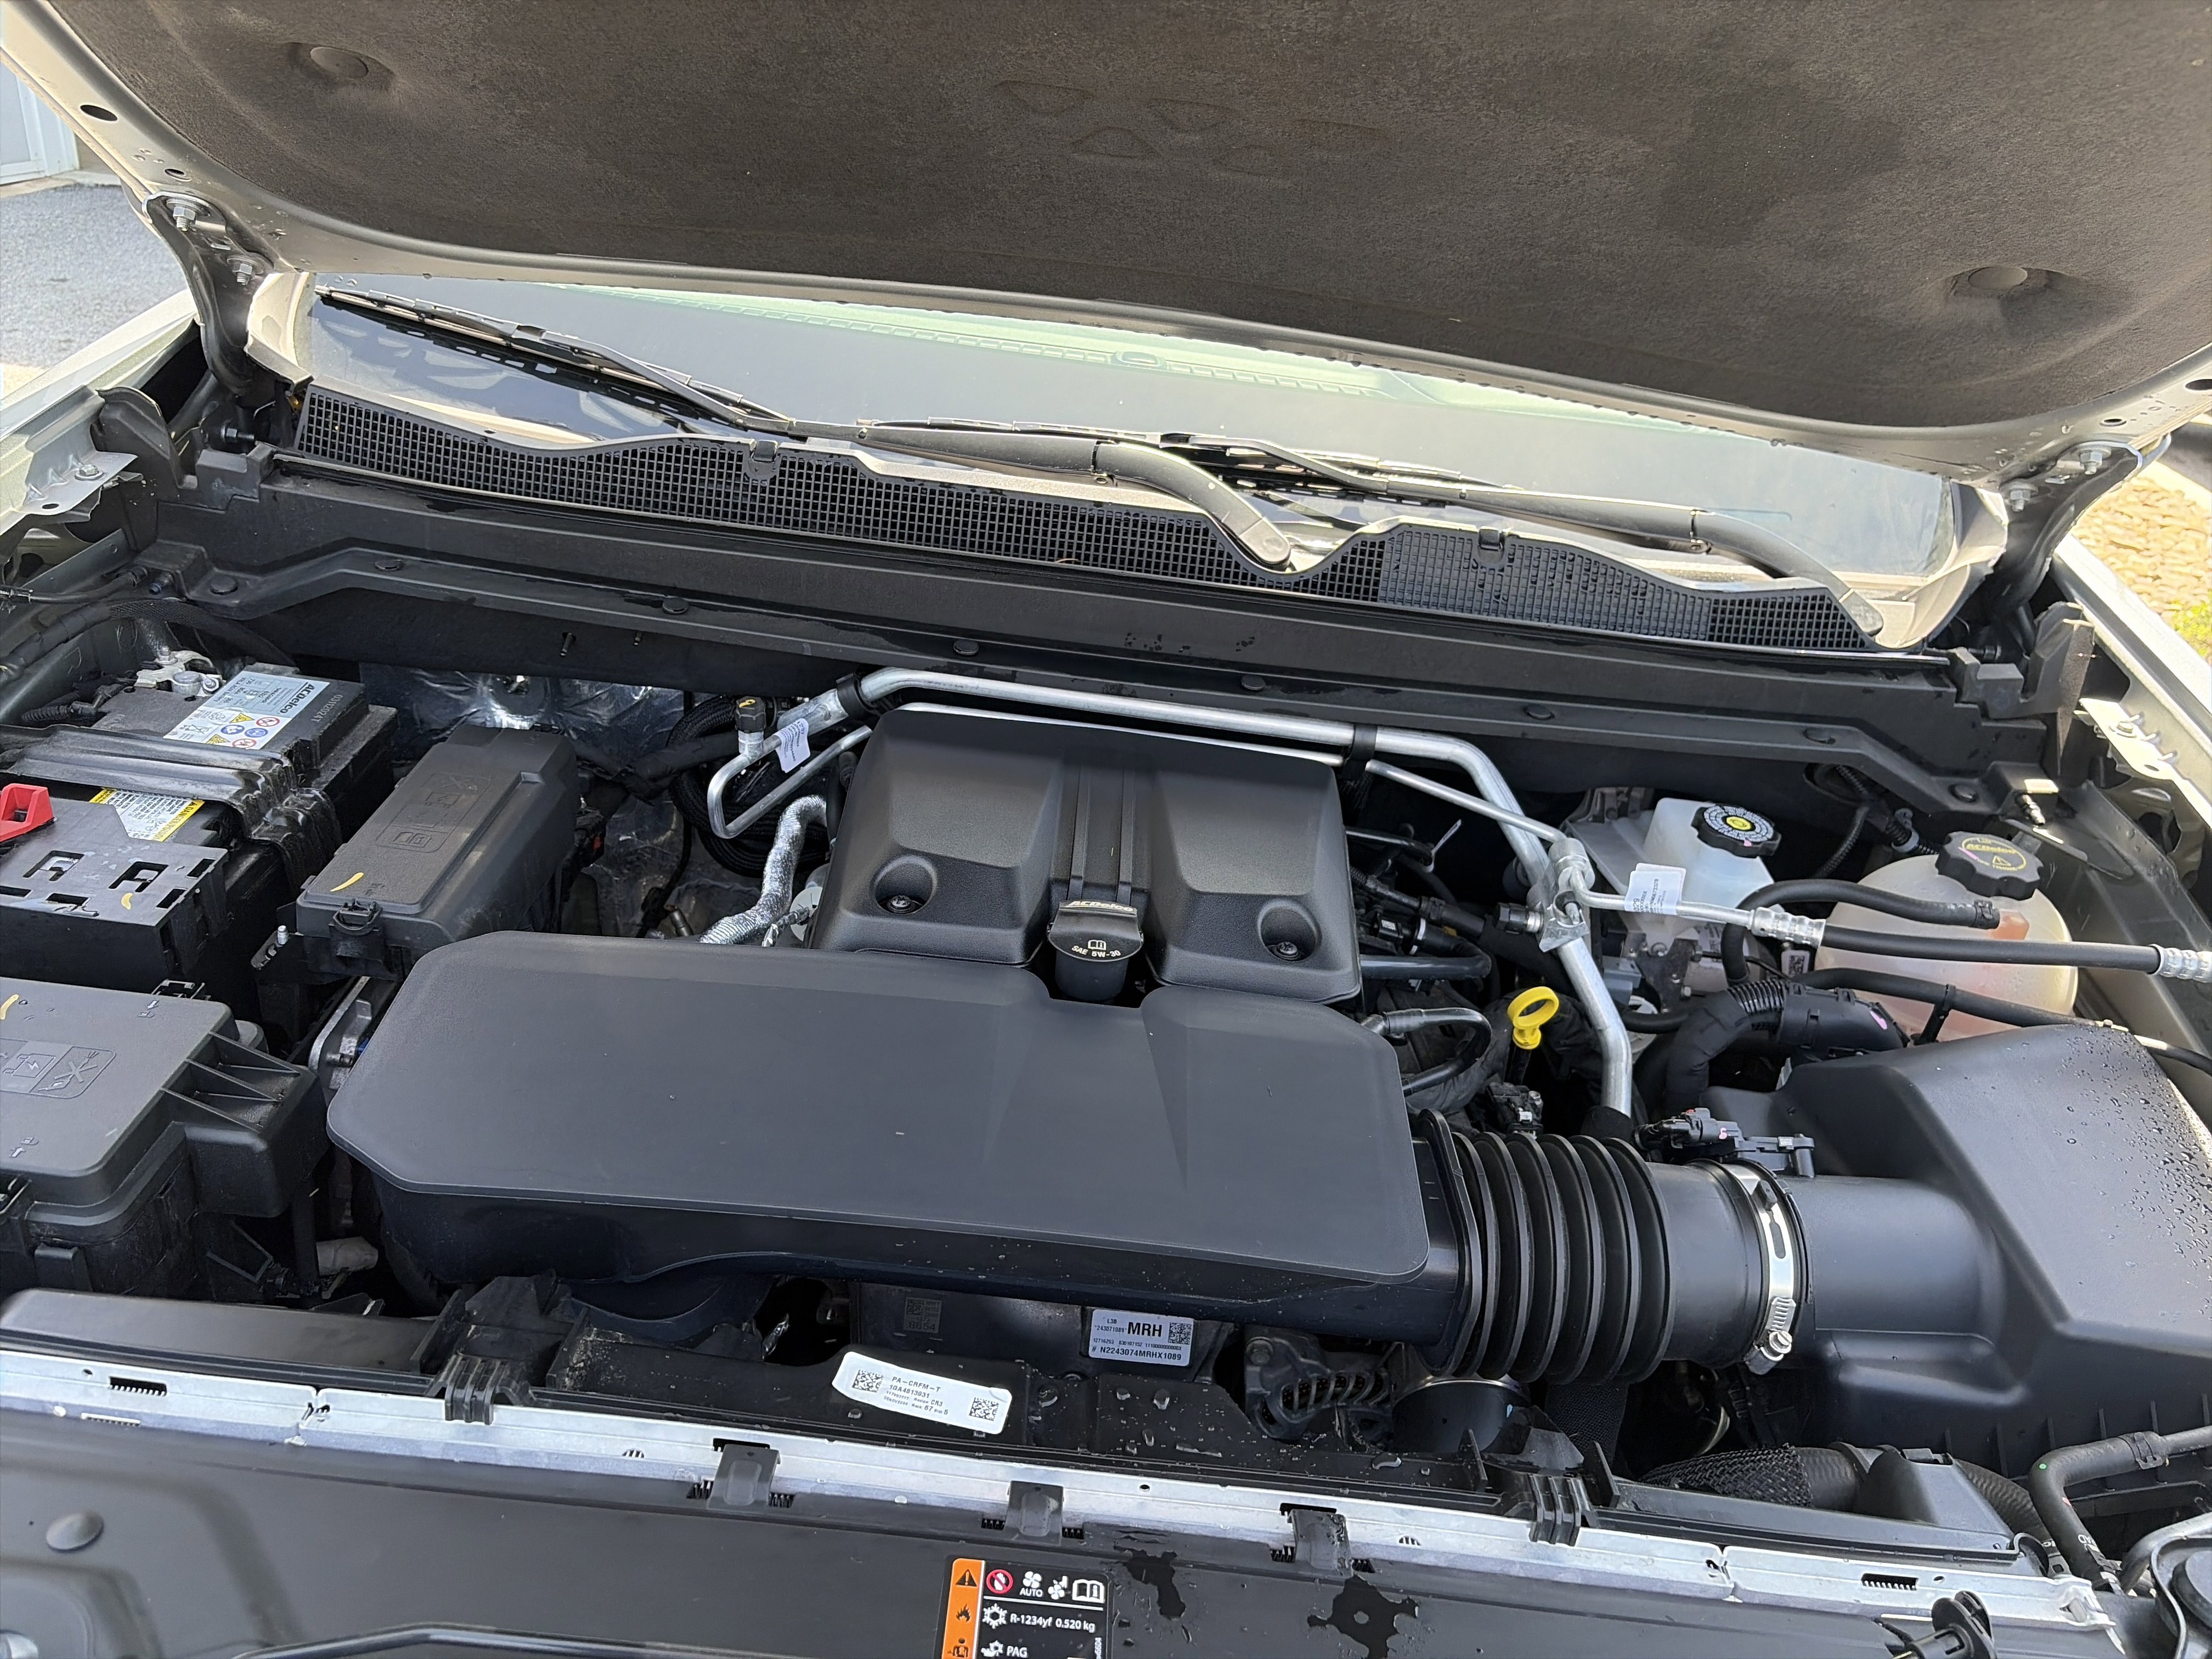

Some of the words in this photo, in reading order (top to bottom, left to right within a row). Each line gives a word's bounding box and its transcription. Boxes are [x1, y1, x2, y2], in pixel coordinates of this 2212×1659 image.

[279, 684, 317, 714] ACDelco
[1068, 901, 1133, 912] ACDelco
[1071, 945, 1088, 955] SAE
[1091, 950, 1121, 958] 5W-30
[1127, 1322, 1163, 1337] MRH
[1100, 1346, 1182, 1361] N2243074MRHX1089
[1019, 1588, 1043, 1598] AUTO
[1010, 1613, 1052, 1628] R-1234yf
[1056, 1618, 1081, 1630] 0.520
[1083, 1621, 1095, 1633] kg
[1007, 1645, 1028, 1658] PAG
